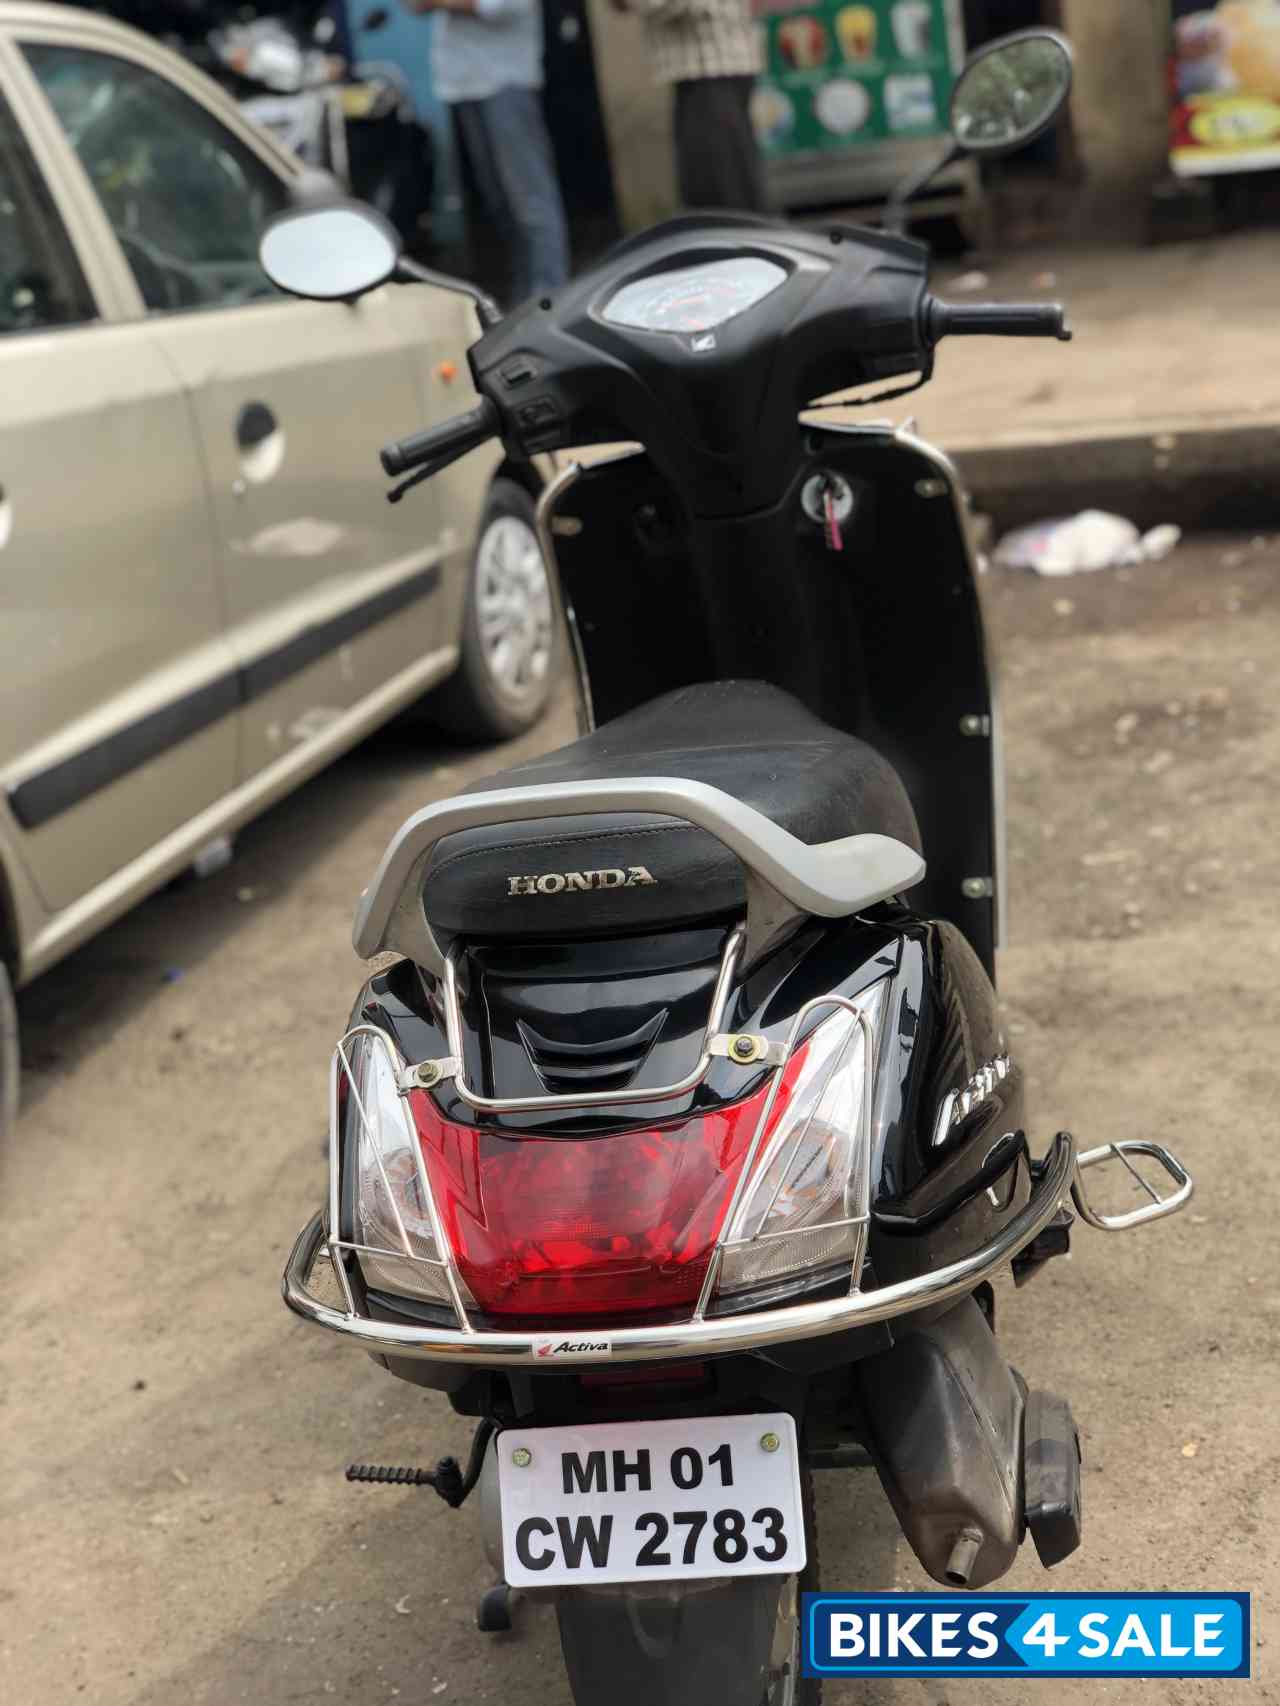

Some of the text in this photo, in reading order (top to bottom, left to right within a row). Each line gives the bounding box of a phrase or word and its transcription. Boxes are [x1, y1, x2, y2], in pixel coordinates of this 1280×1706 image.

[507, 866, 658, 896] HONDA
[553, 1341, 609, 1353] Activa
[561, 1443, 734, 1494] MH 01
[515, 1507, 788, 1571] CW 2783
